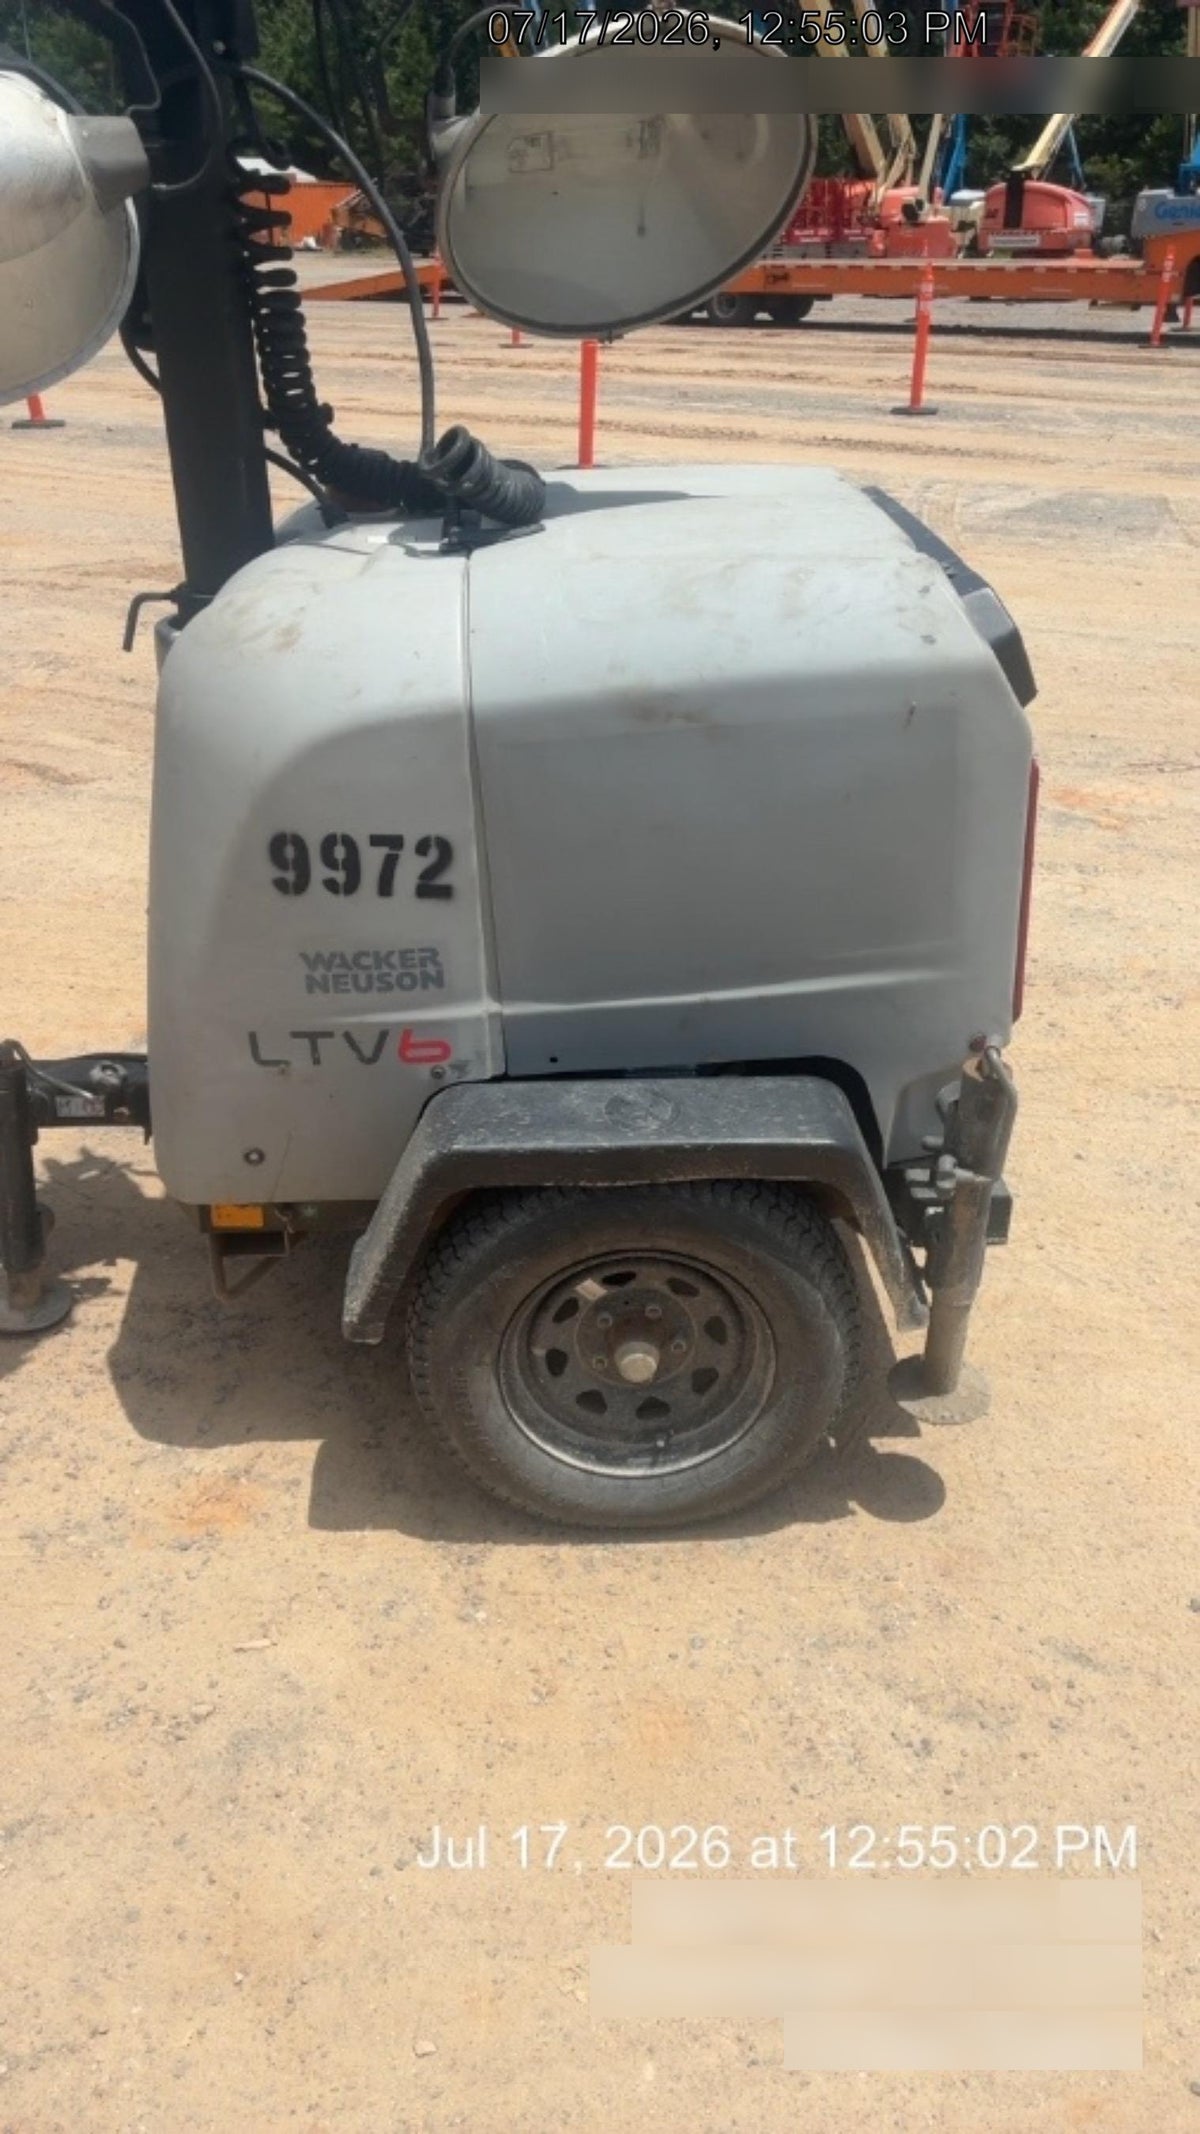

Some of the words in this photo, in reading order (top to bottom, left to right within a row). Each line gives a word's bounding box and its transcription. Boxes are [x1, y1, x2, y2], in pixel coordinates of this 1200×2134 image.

[268, 831, 454, 900] 9972
[300, 948, 442, 972] WACKER
[305, 969, 444, 994] NEUSON
